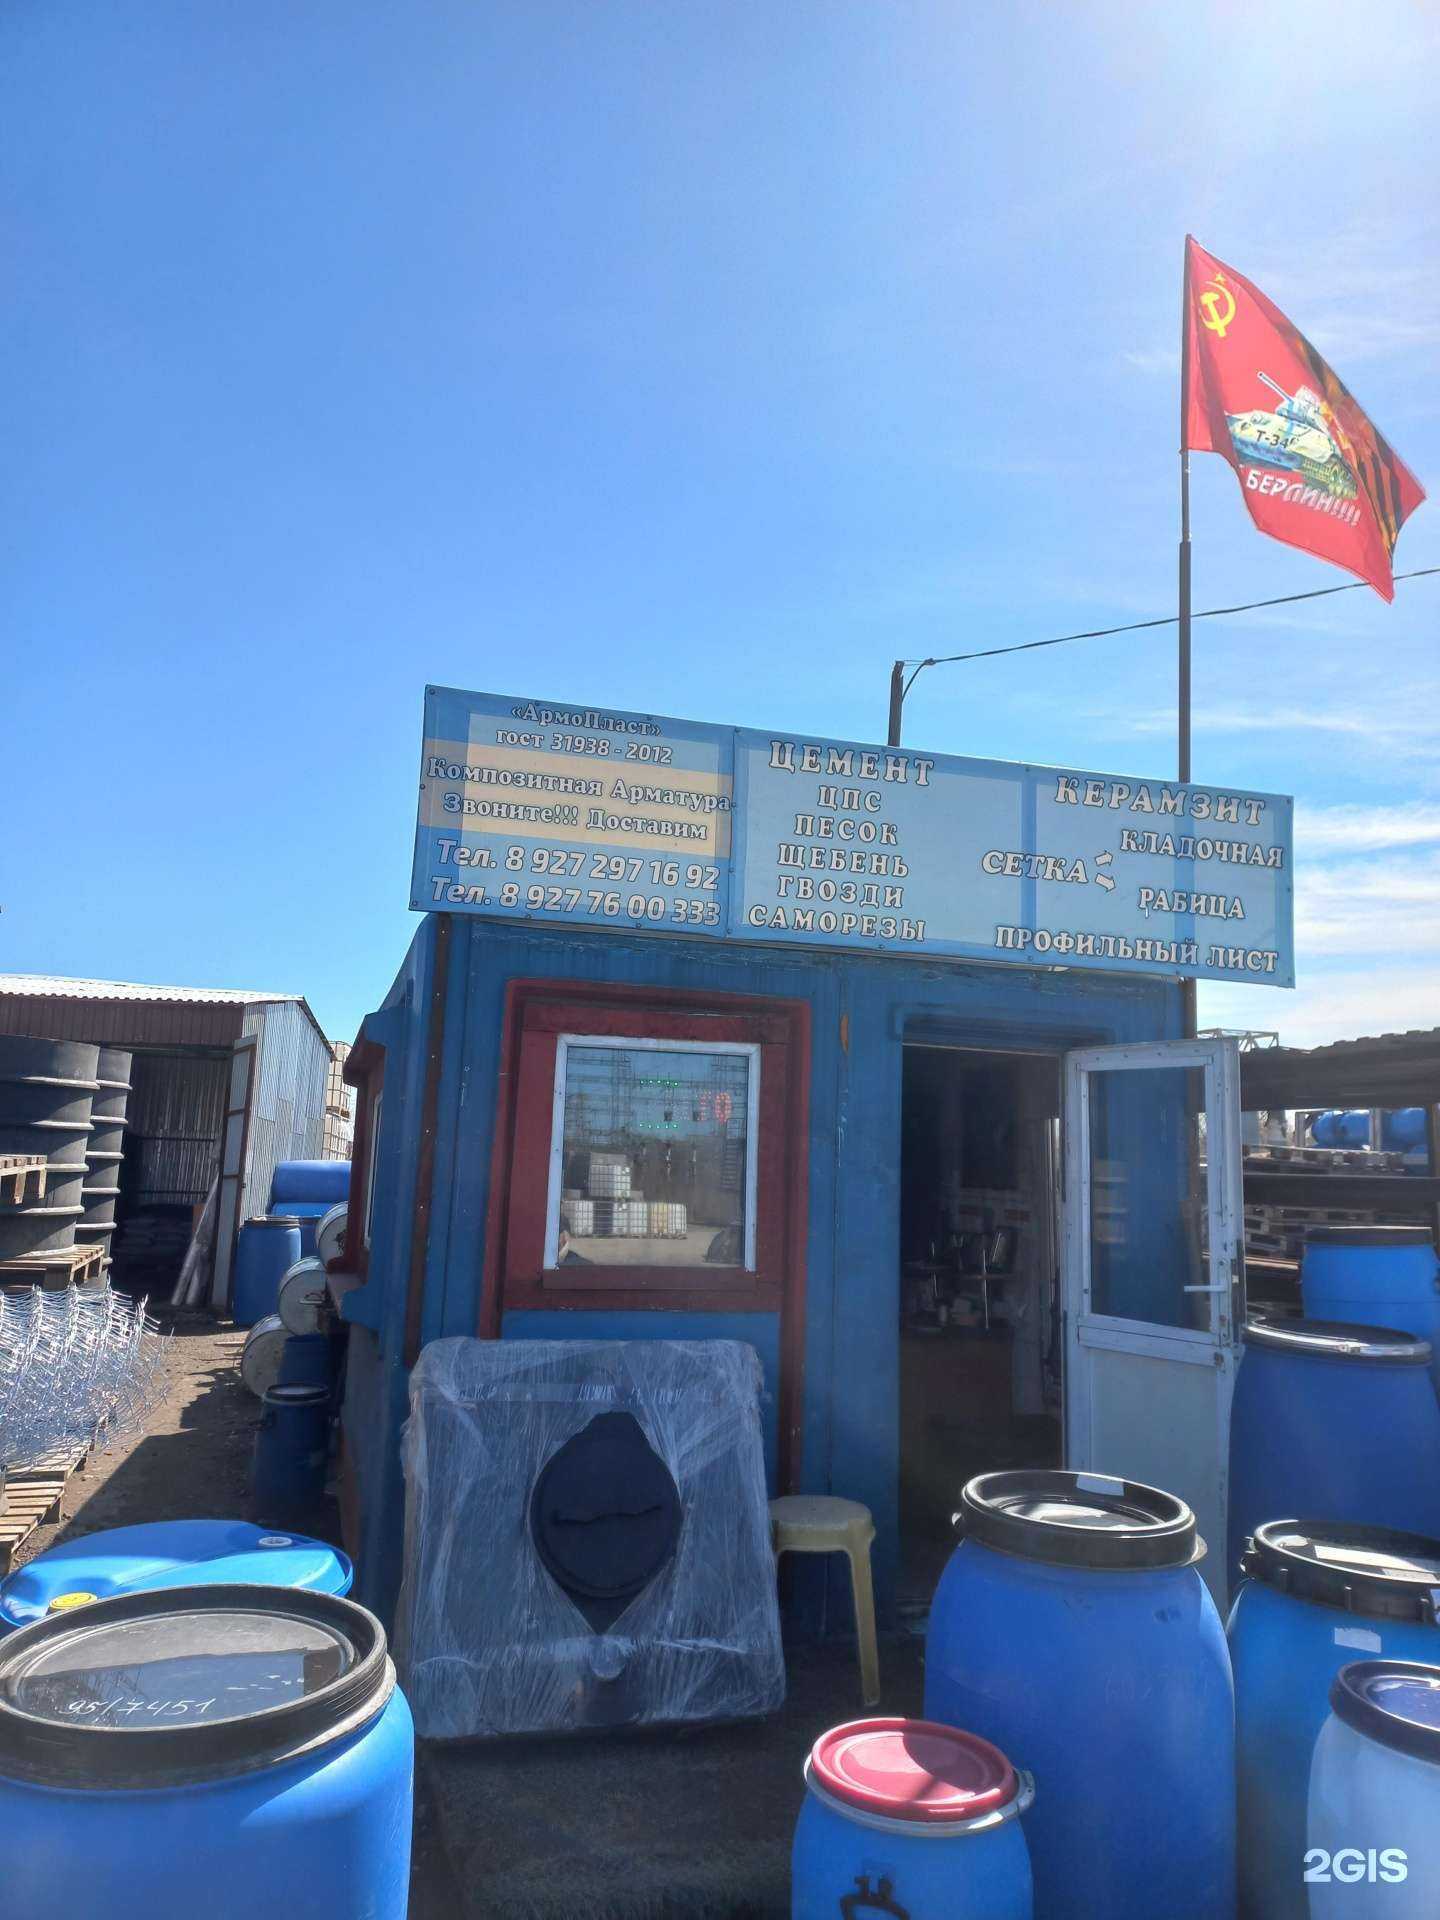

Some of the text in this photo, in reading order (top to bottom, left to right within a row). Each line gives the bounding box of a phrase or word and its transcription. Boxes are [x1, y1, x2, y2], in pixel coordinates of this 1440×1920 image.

[512, 703, 662, 737] «АрмоПласт»
[496, 729, 544, 749] гост
[551, 733, 610, 756] 31938
[626, 743, 672, 764] 2012
[769, 740, 934, 786] ЦЕМЕНТ
[427, 757, 732, 811] Композитная Арматура
[817, 785, 882, 812] ЦПС
[1055, 776, 1265, 825] КЕРАМЗИТ
[443, 793, 707, 840] Звоните!!! Доставим
[794, 814, 898, 845] ПЕСОК
[436, 839, 720, 890] Тел. 8 927 297 16 92
[777, 844, 909, 877] ЩЕБЕНЬ
[982, 850, 1088, 884] СЕТКА
[1120, 829, 1283, 868] КЛАДОЧНАЯ
[431, 876, 720, 926] Тел. 8 927 76 00 333
[777, 875, 904, 909] ГВОЗДИ
[1138, 887, 1246, 919] РАБИЦА
[749, 904, 926, 942] САМОРЕЗЫ
[995, 926, 1279, 973] ПРОФИЛЬНЫЙ ЛИСТ
